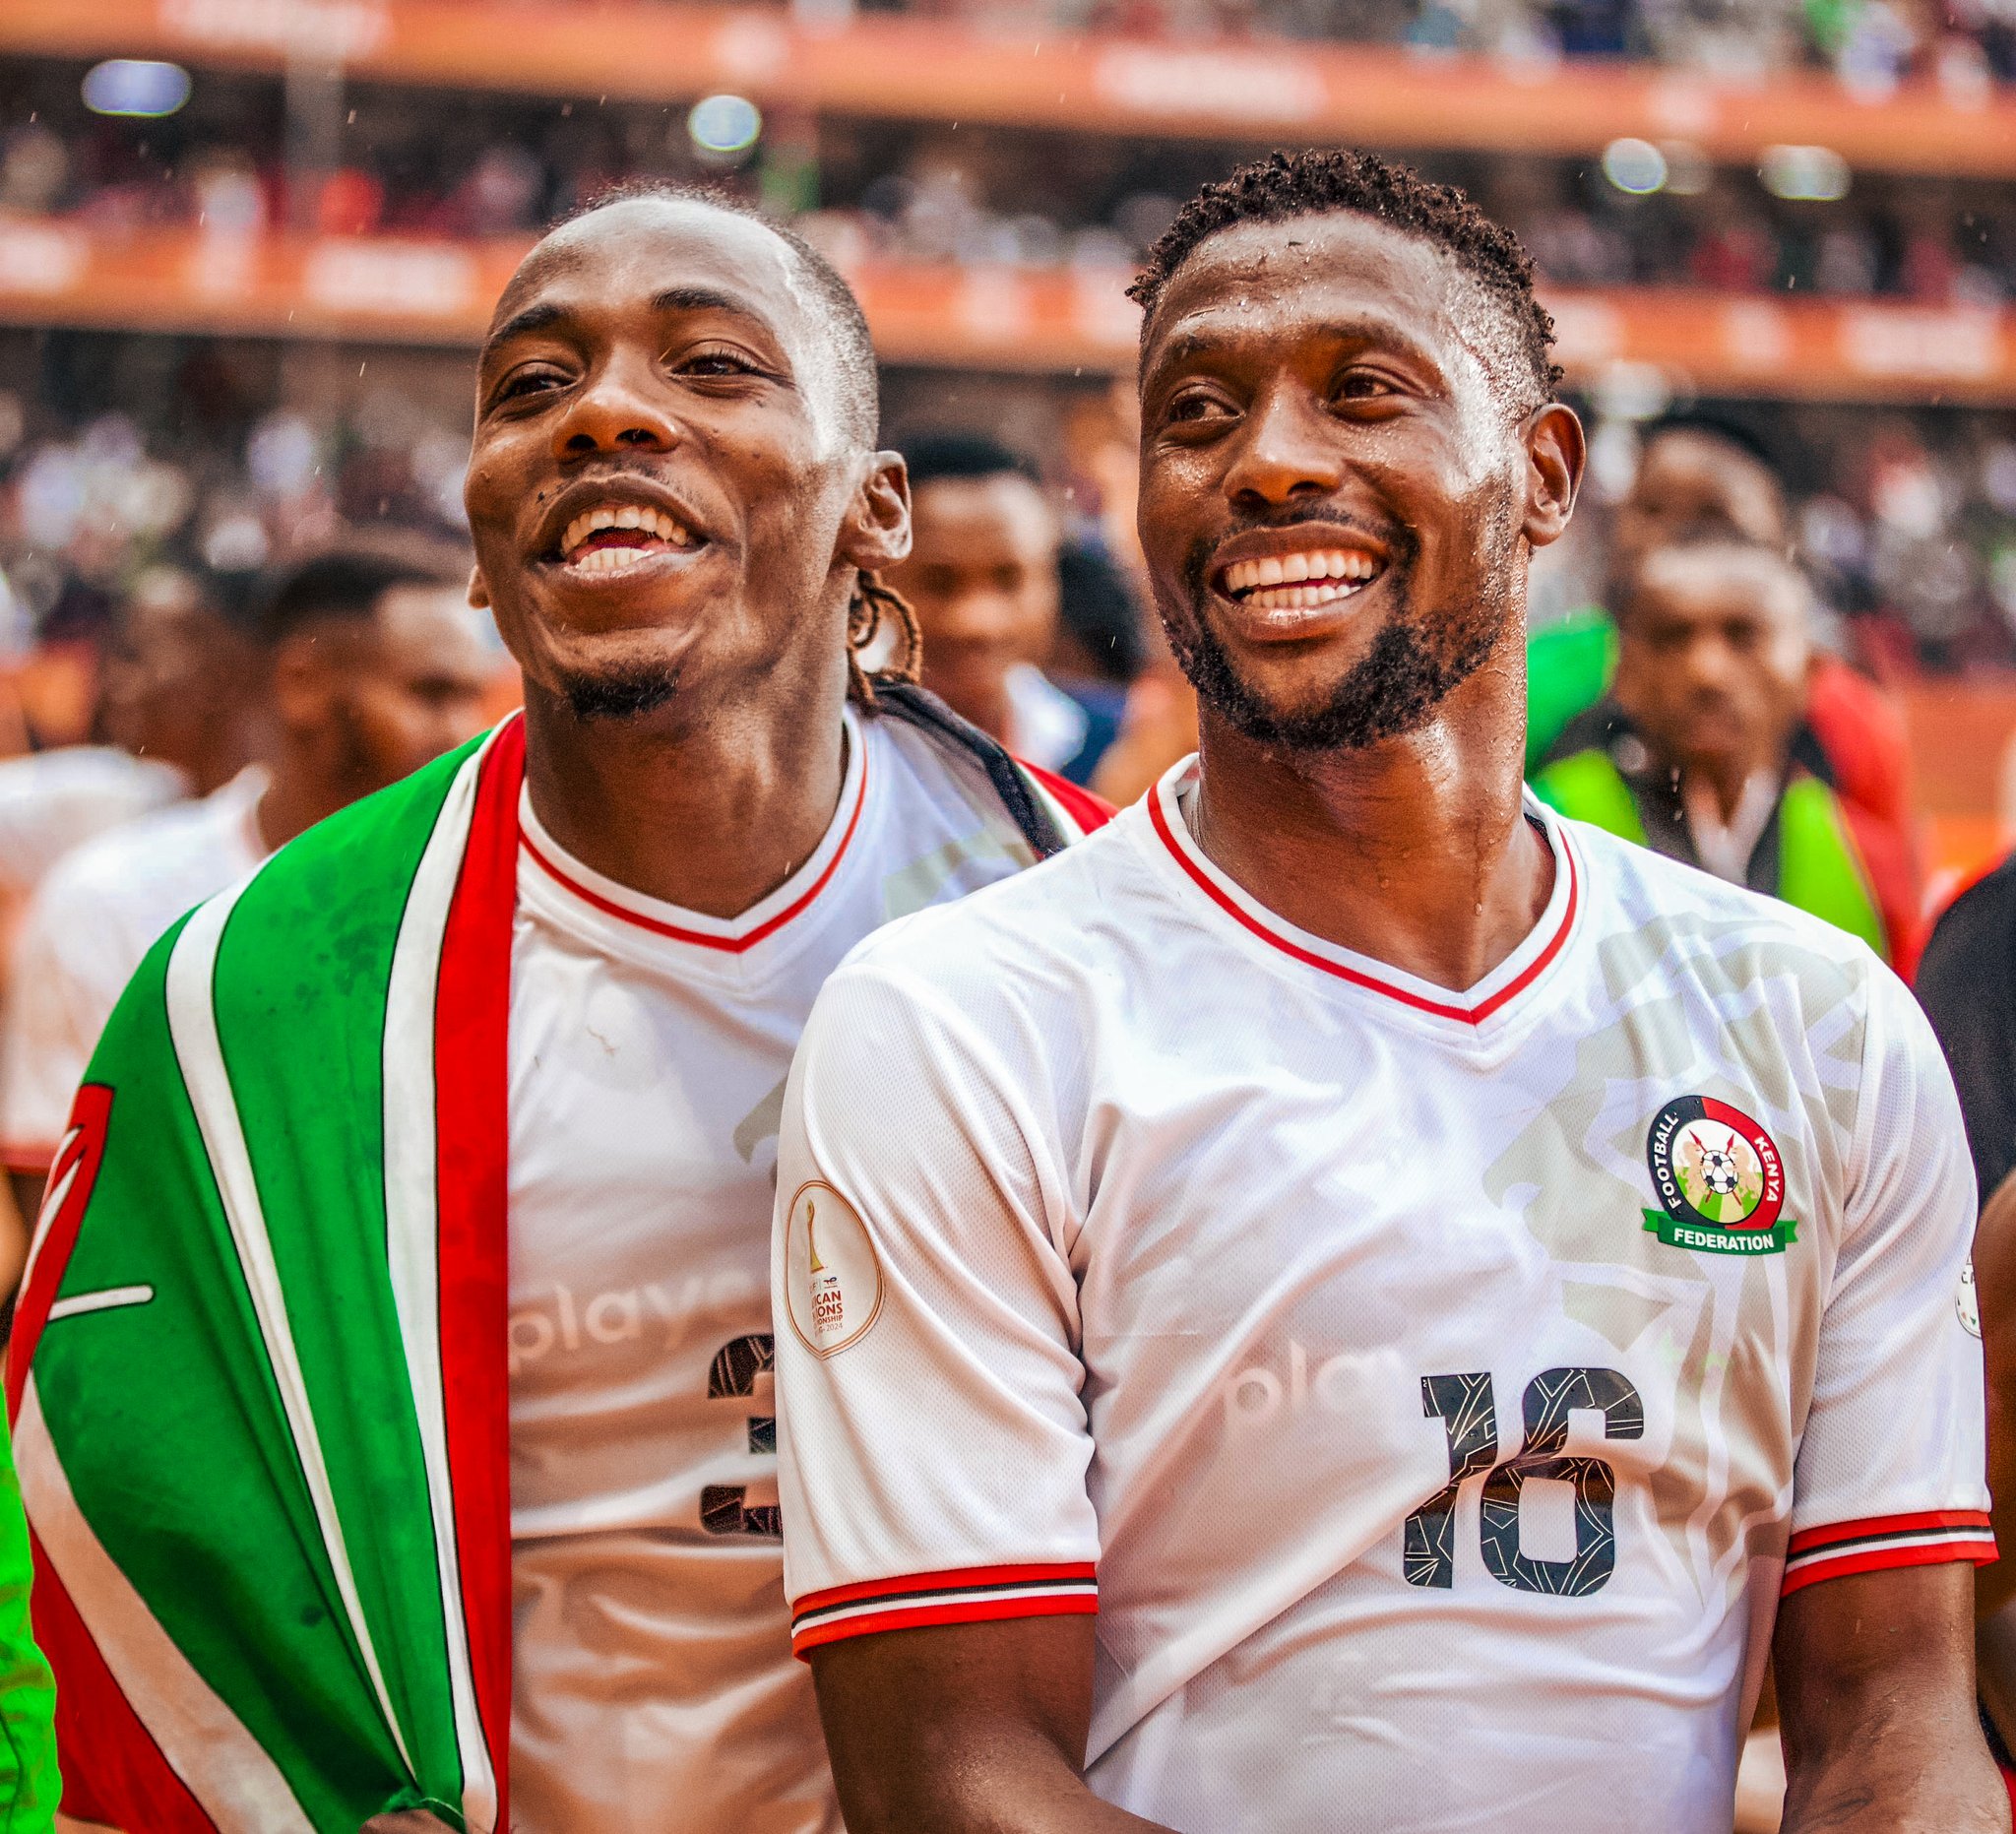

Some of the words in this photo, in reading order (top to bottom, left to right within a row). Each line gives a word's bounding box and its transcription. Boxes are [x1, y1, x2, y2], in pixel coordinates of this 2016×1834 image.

[1654, 1112, 1681, 1210] FOOTBALL
[1754, 1136, 1779, 1202] KENYA
[1673, 1228, 1774, 1250] FEDERATION
[509, 1277, 740, 1375] play
[1403, 1367, 1644, 1597] 16
